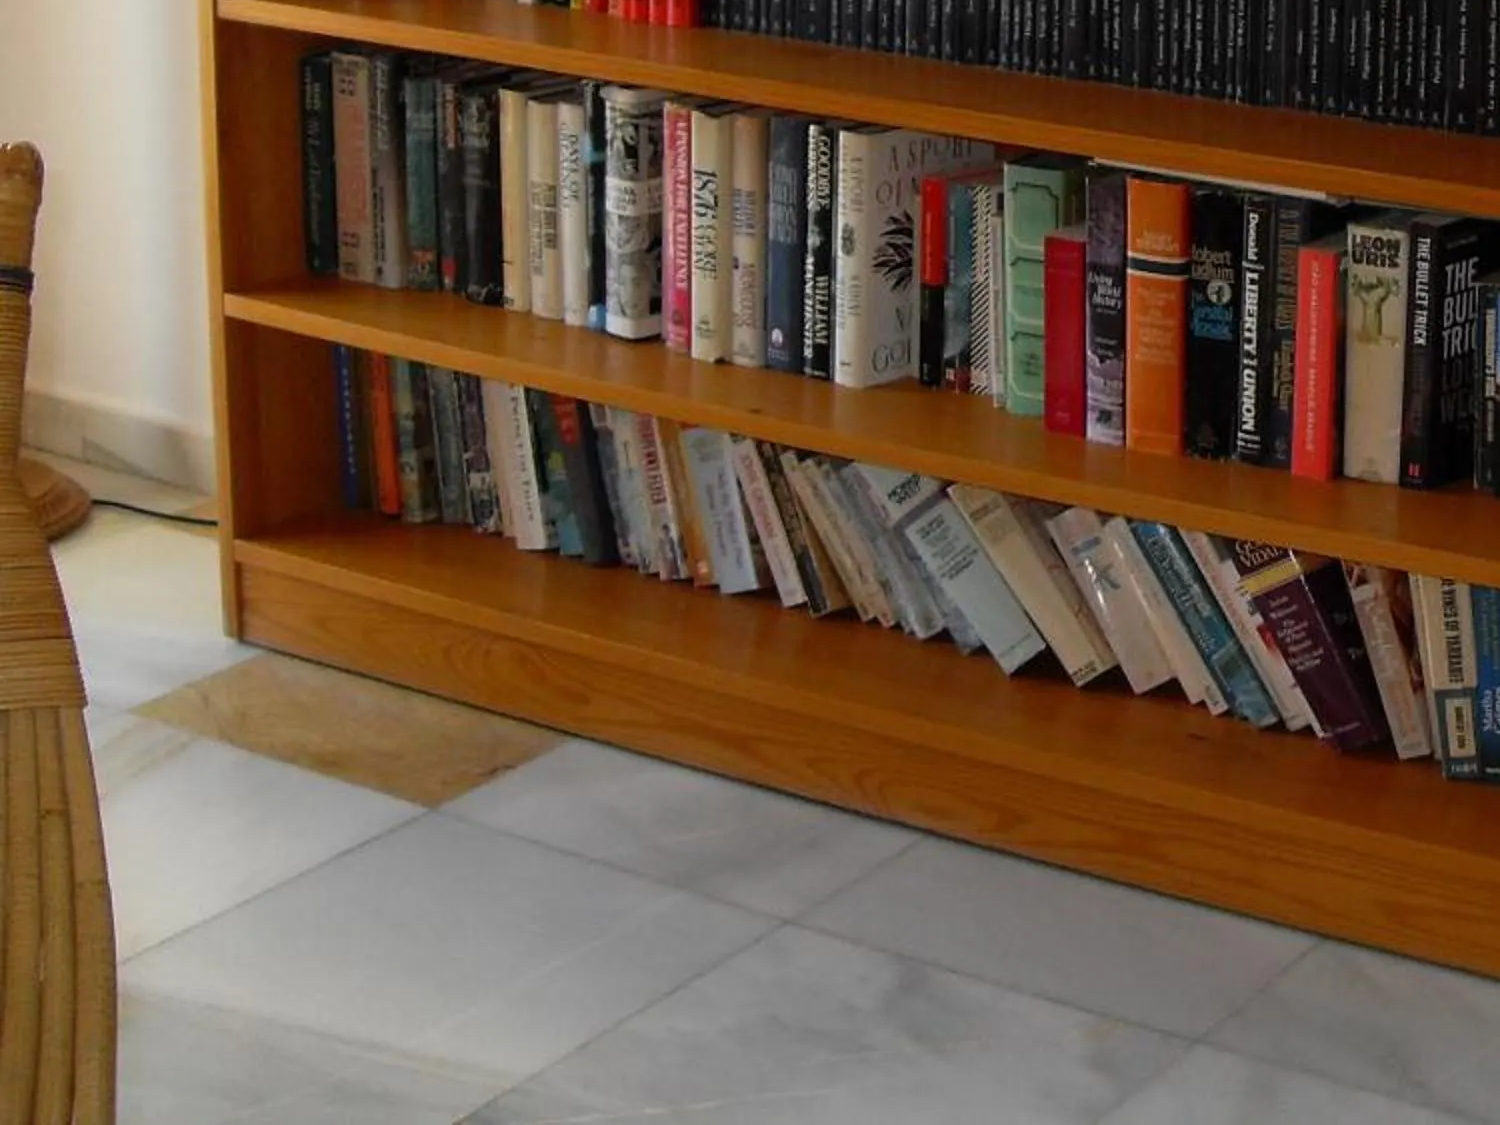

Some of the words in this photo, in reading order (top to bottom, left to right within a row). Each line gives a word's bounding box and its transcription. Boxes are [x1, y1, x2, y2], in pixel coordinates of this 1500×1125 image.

[694, 170, 718, 220] 1876
[1192, 243, 1232, 265] obert
[1248, 212, 1259, 261] Donald
[1352, 234, 1401, 256] LEON
[1352, 247, 1400, 268] URIS
[1417, 237, 1431, 260] THE
[1192, 260, 1235, 284] udlum
[1415, 262, 1429, 308] BULLET
[1445, 256, 1480, 295] THE
[803, 254, 815, 360] MANCHESTER
[816, 274, 829, 345] WILLIAM
[1244, 272, 1259, 357] LIBERTY
[1413, 310, 1428, 347] TRICK
[1241, 368, 1258, 433] UNION
